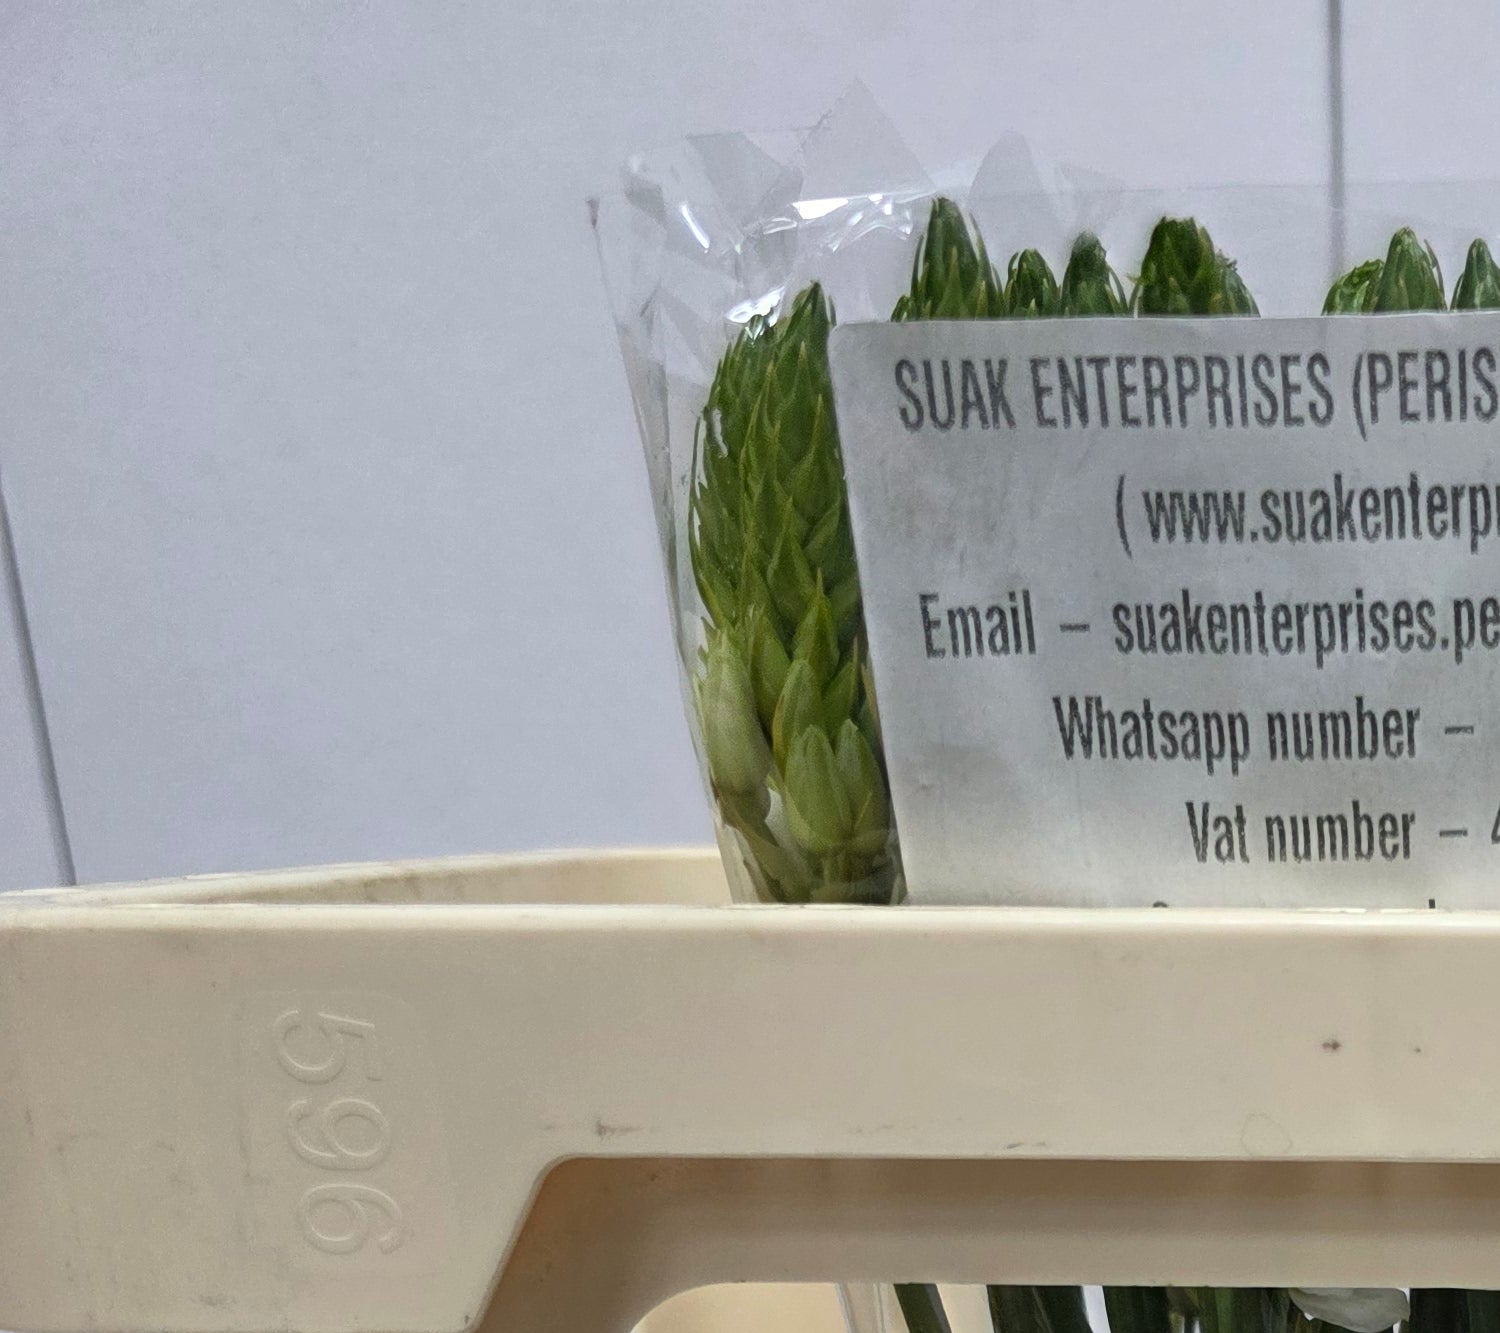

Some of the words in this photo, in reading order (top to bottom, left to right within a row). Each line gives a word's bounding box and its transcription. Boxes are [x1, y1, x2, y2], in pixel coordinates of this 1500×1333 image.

[894, 357, 1017, 434] SUAK
[1027, 351, 1335, 430] ENTERPRISES
[918, 588, 1037, 659] Email
[1051, 695, 1250, 777] Whatsapp
[1266, 695, 1421, 760] number
[1184, 800, 1250, 864] Vat
[1264, 798, 1416, 863] number
